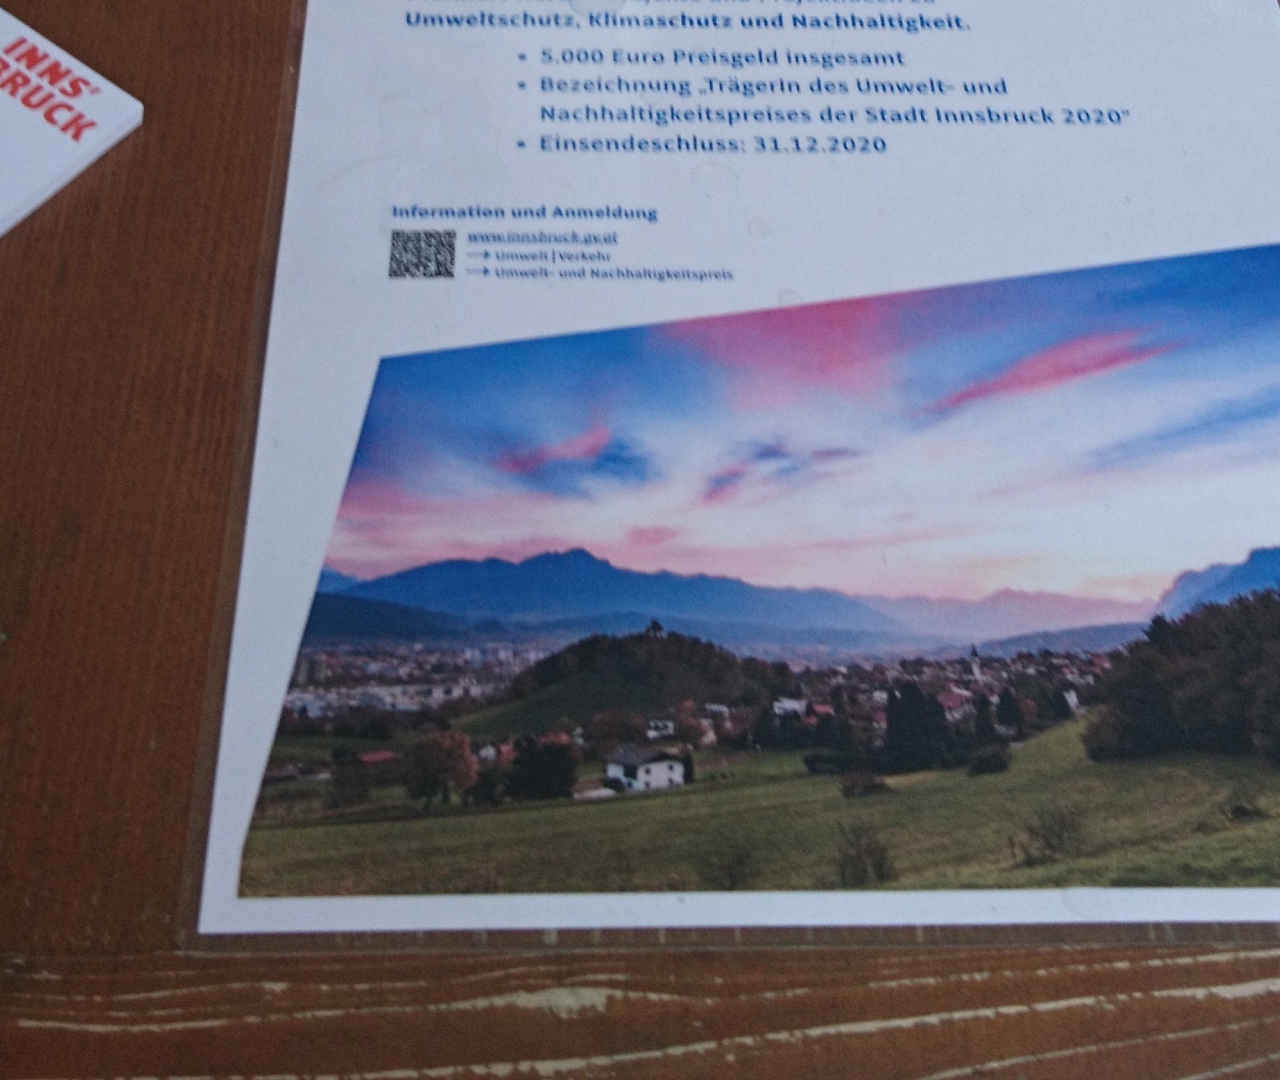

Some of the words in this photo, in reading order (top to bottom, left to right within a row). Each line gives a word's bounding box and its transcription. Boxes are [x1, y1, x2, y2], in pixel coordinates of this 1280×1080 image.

[405, 11, 581, 31] Umweltschutz,
[588, 11, 732, 30] Klimaschutz
[739, 12, 784, 30] und
[791, 11, 973, 34] Nachhaltigkeit.
[1, 35, 102, 100] INNS'
[540, 48, 604, 67] 5.000
[611, 49, 666, 67] Euro
[673, 48, 779, 70] Preisgeld
[785, 48, 906, 70] insgesamt
[540, 76, 692, 98] Bezeichnung
[809, 76, 851, 95] des
[856, 77, 957, 96] Umwelt-
[963, 77, 1009, 96] und
[540, 104, 813, 128] Nachhaltigkeitspreises
[818, 106, 860, 125] der
[865, 106, 929, 125] Stadt
[935, 106, 1055, 126] Innsbruck
[539, 134, 748, 155] Einsendeschluss:
[753, 135, 888, 155] 31.12.2020
[391, 204, 506, 220] Information
[511, 205, 547, 220] und
[552, 205, 659, 223] Anmeldung
[590, 267, 734, 284] Nachhaltigkeitspreis
